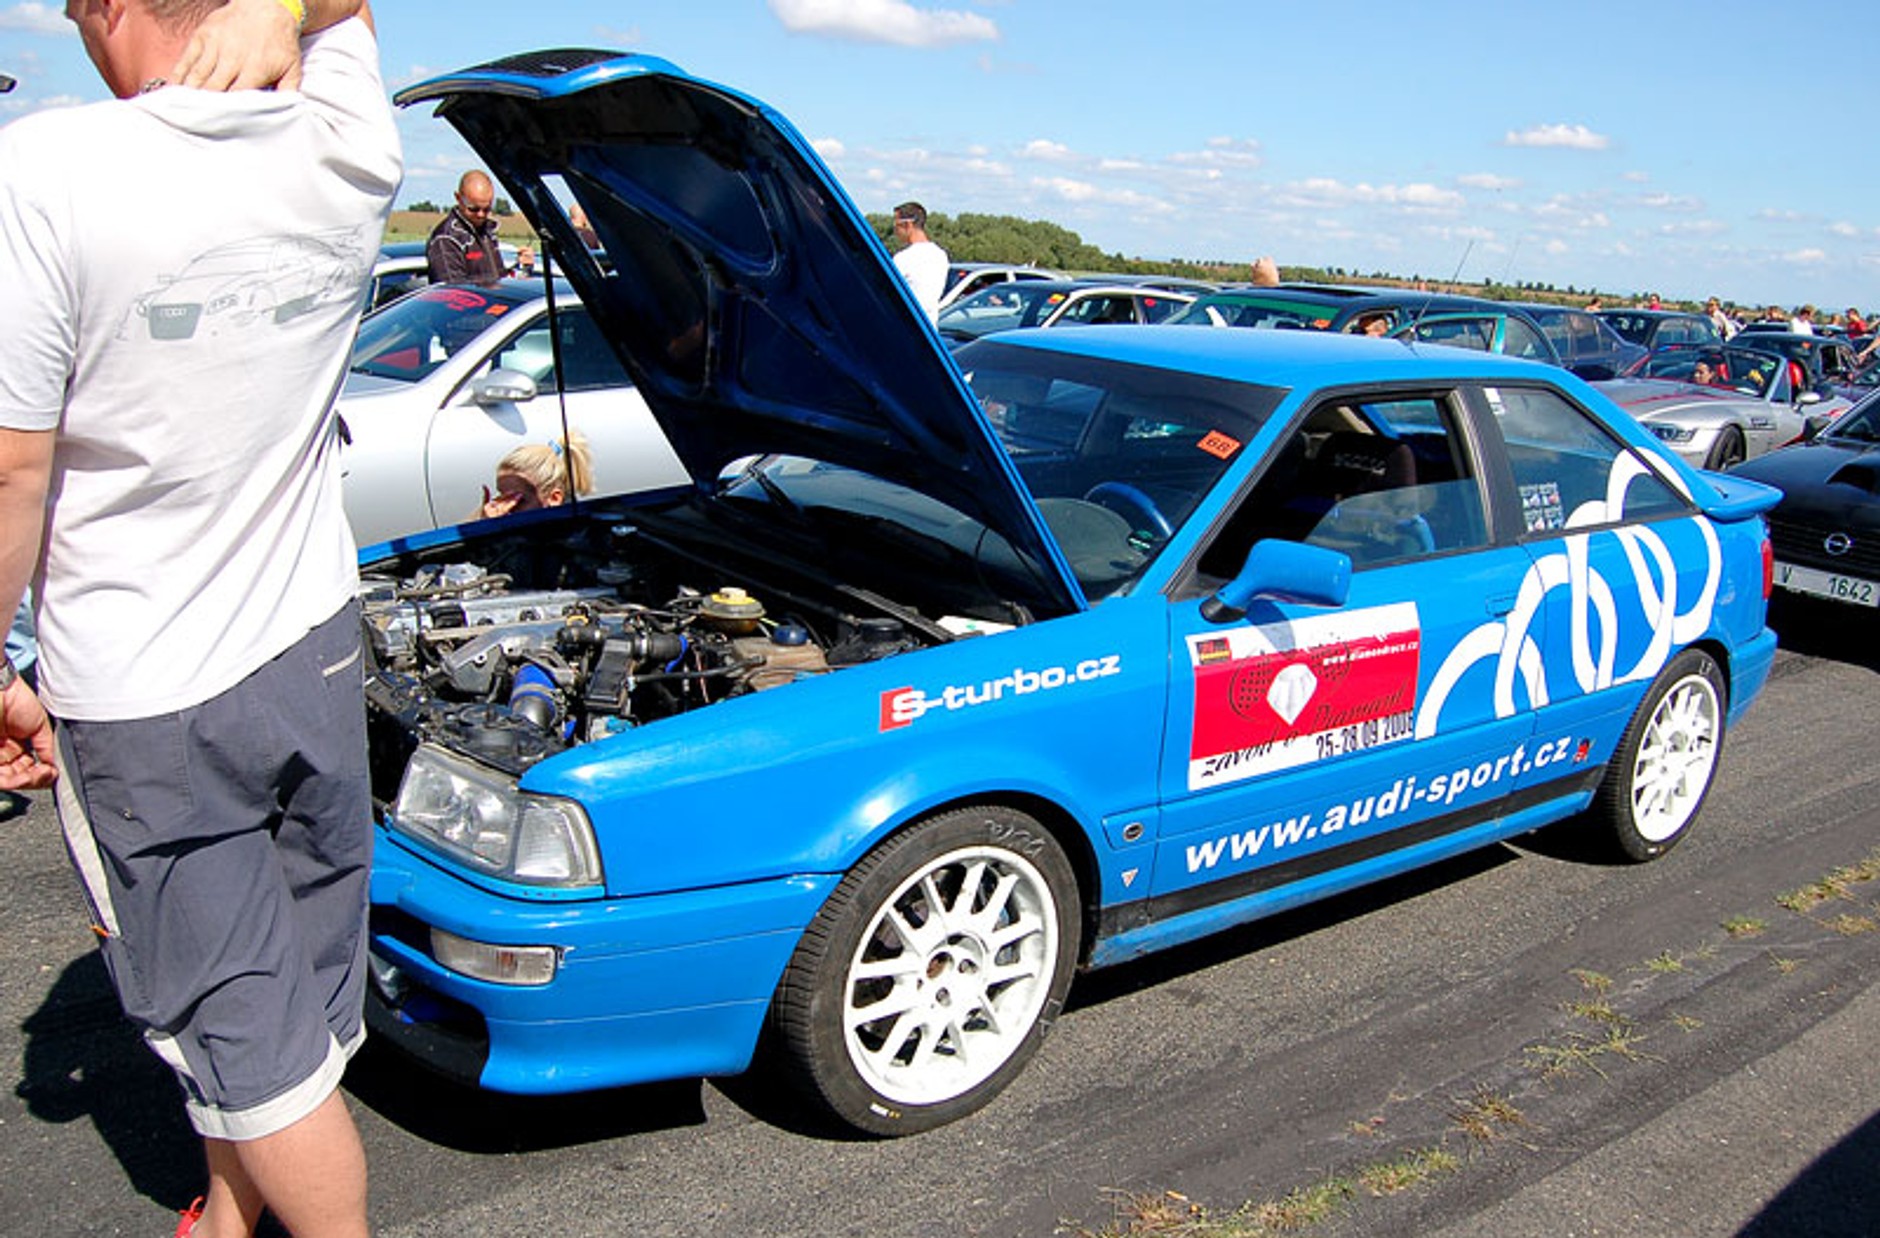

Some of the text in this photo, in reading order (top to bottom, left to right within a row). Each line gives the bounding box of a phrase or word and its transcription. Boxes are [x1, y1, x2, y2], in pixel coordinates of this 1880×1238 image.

[1828, 576, 1873, 603] 1642
[890, 654, 1121, 723] S-turbo.cz
[1184, 736, 1570, 874] www.audi-sport.cz
